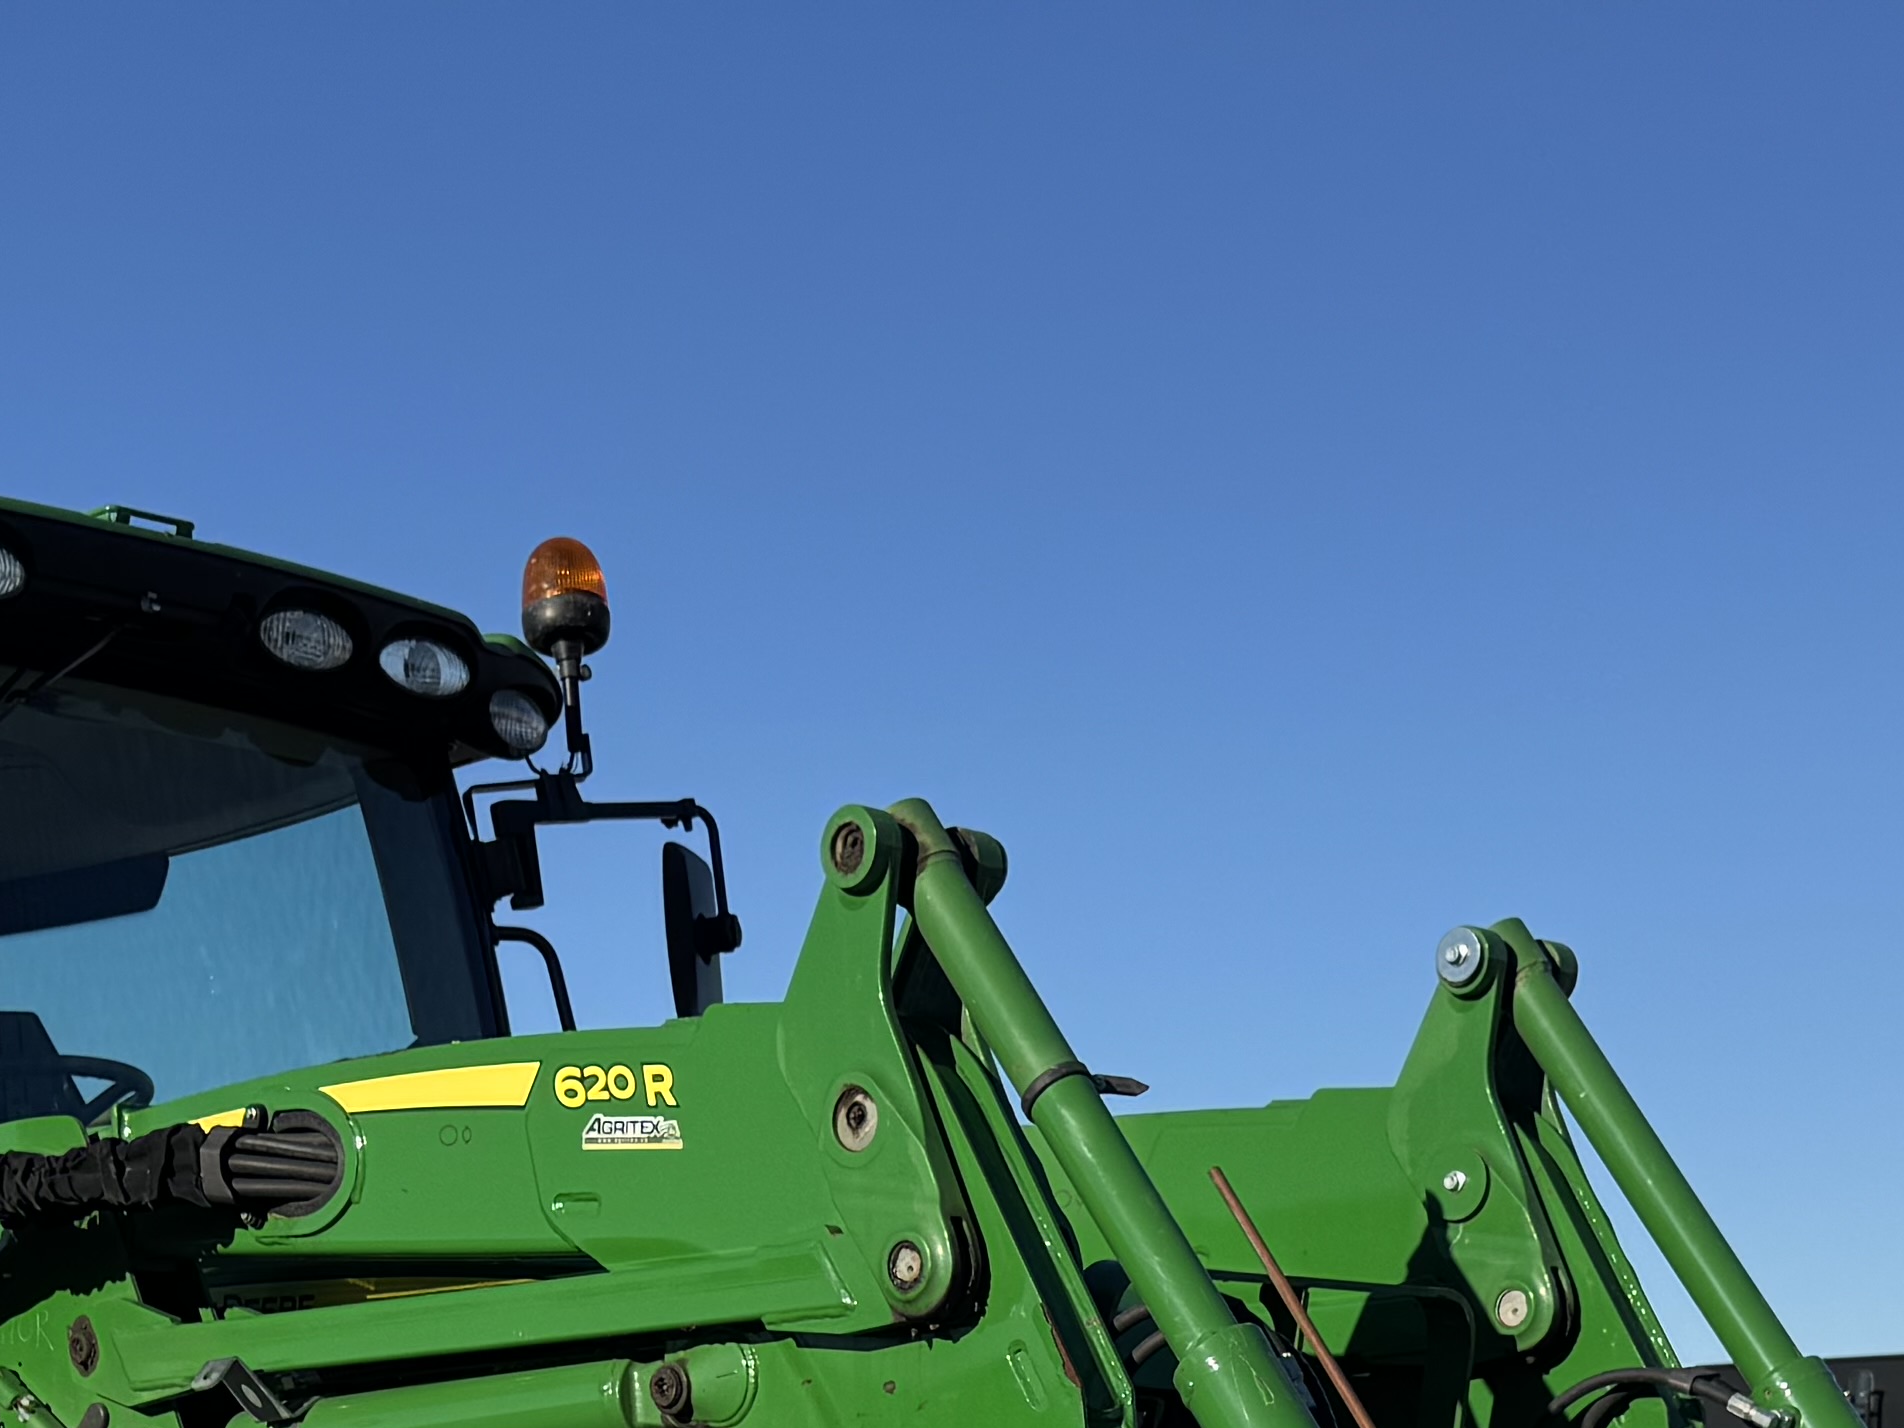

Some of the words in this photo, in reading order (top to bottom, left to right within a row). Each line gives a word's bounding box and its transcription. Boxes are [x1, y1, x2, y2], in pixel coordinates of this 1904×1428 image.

[554, 1065, 637, 1108] 620
[642, 1063, 678, 1107] R
[586, 1117, 661, 1135] AGRITEX
